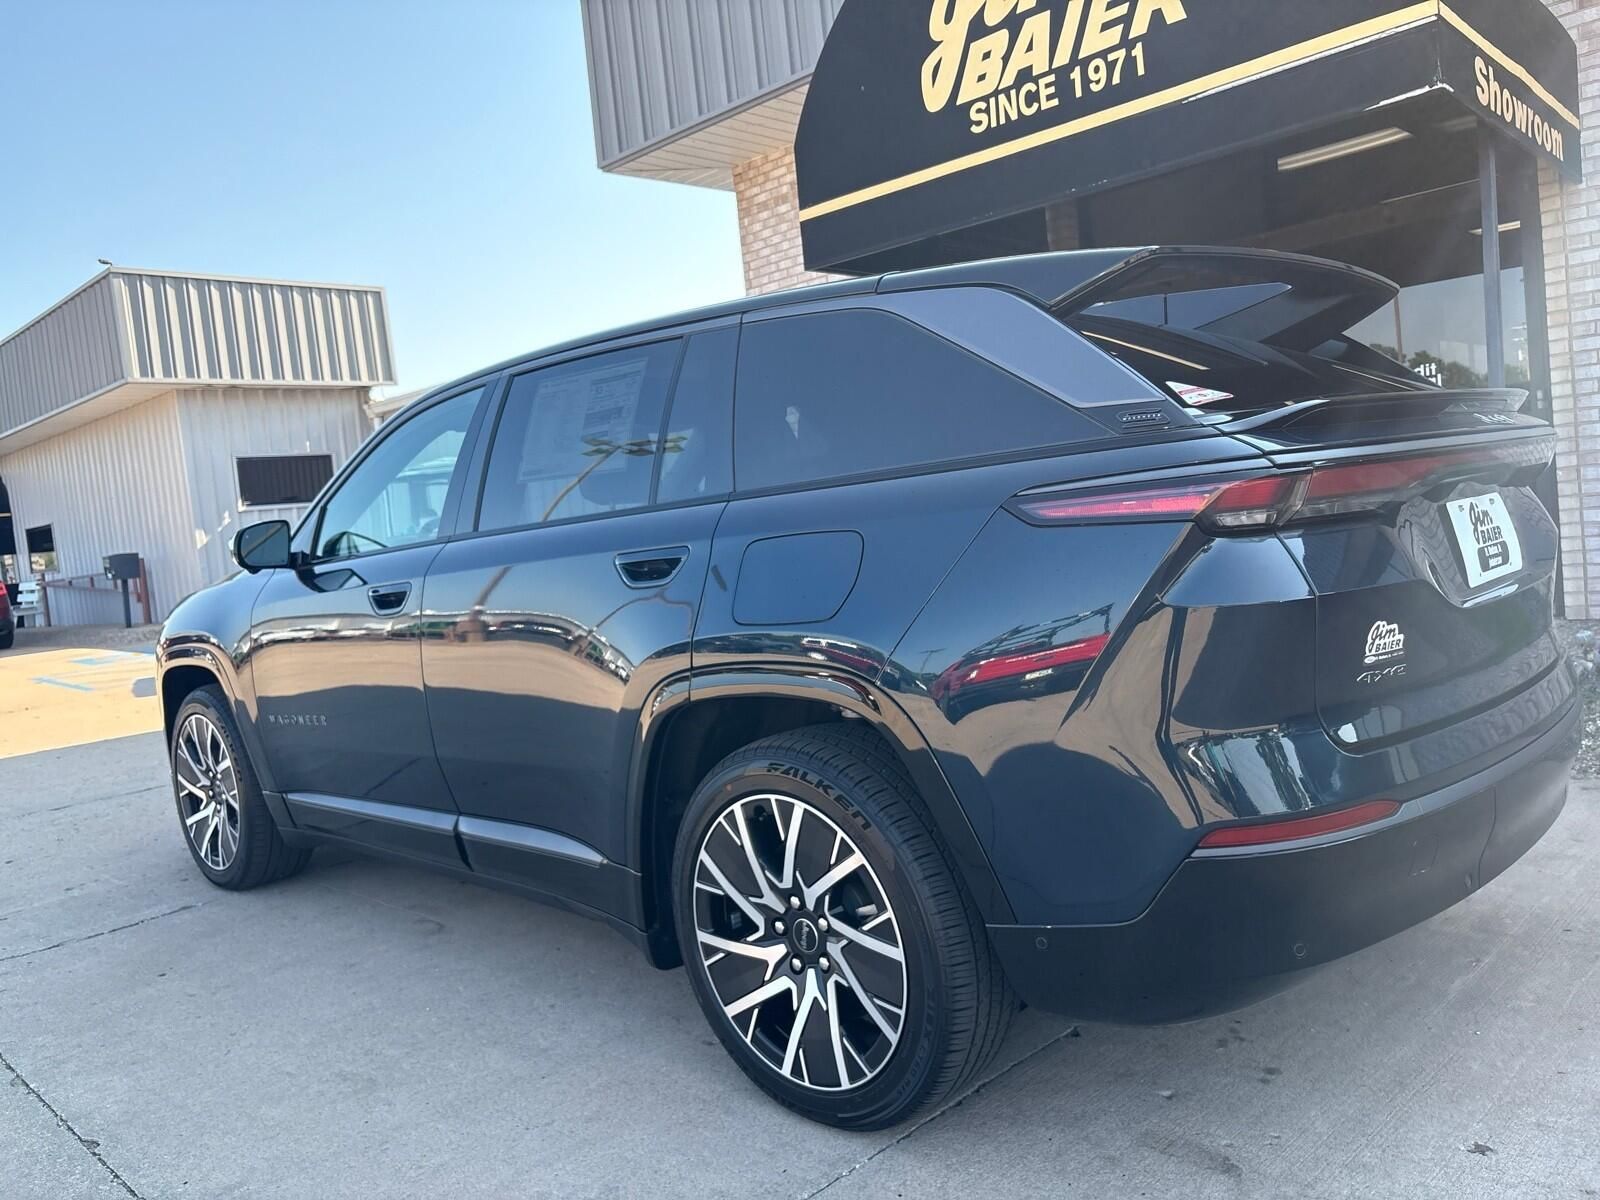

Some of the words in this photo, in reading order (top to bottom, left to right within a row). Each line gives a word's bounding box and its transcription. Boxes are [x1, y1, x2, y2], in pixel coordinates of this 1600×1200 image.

[969, 74, 1059, 134] SINCE
[1070, 41, 1145, 98] 1971
[1474, 55, 1564, 162] Showroom
[1468, 501, 1494, 546] Jim
[1480, 525, 1503, 545] BAIER
[1368, 623, 1397, 654] Jim
[1375, 638, 1402, 653] BAIER
[268, 713, 328, 727] WAGONEER
[766, 762, 872, 831] FALKEN
